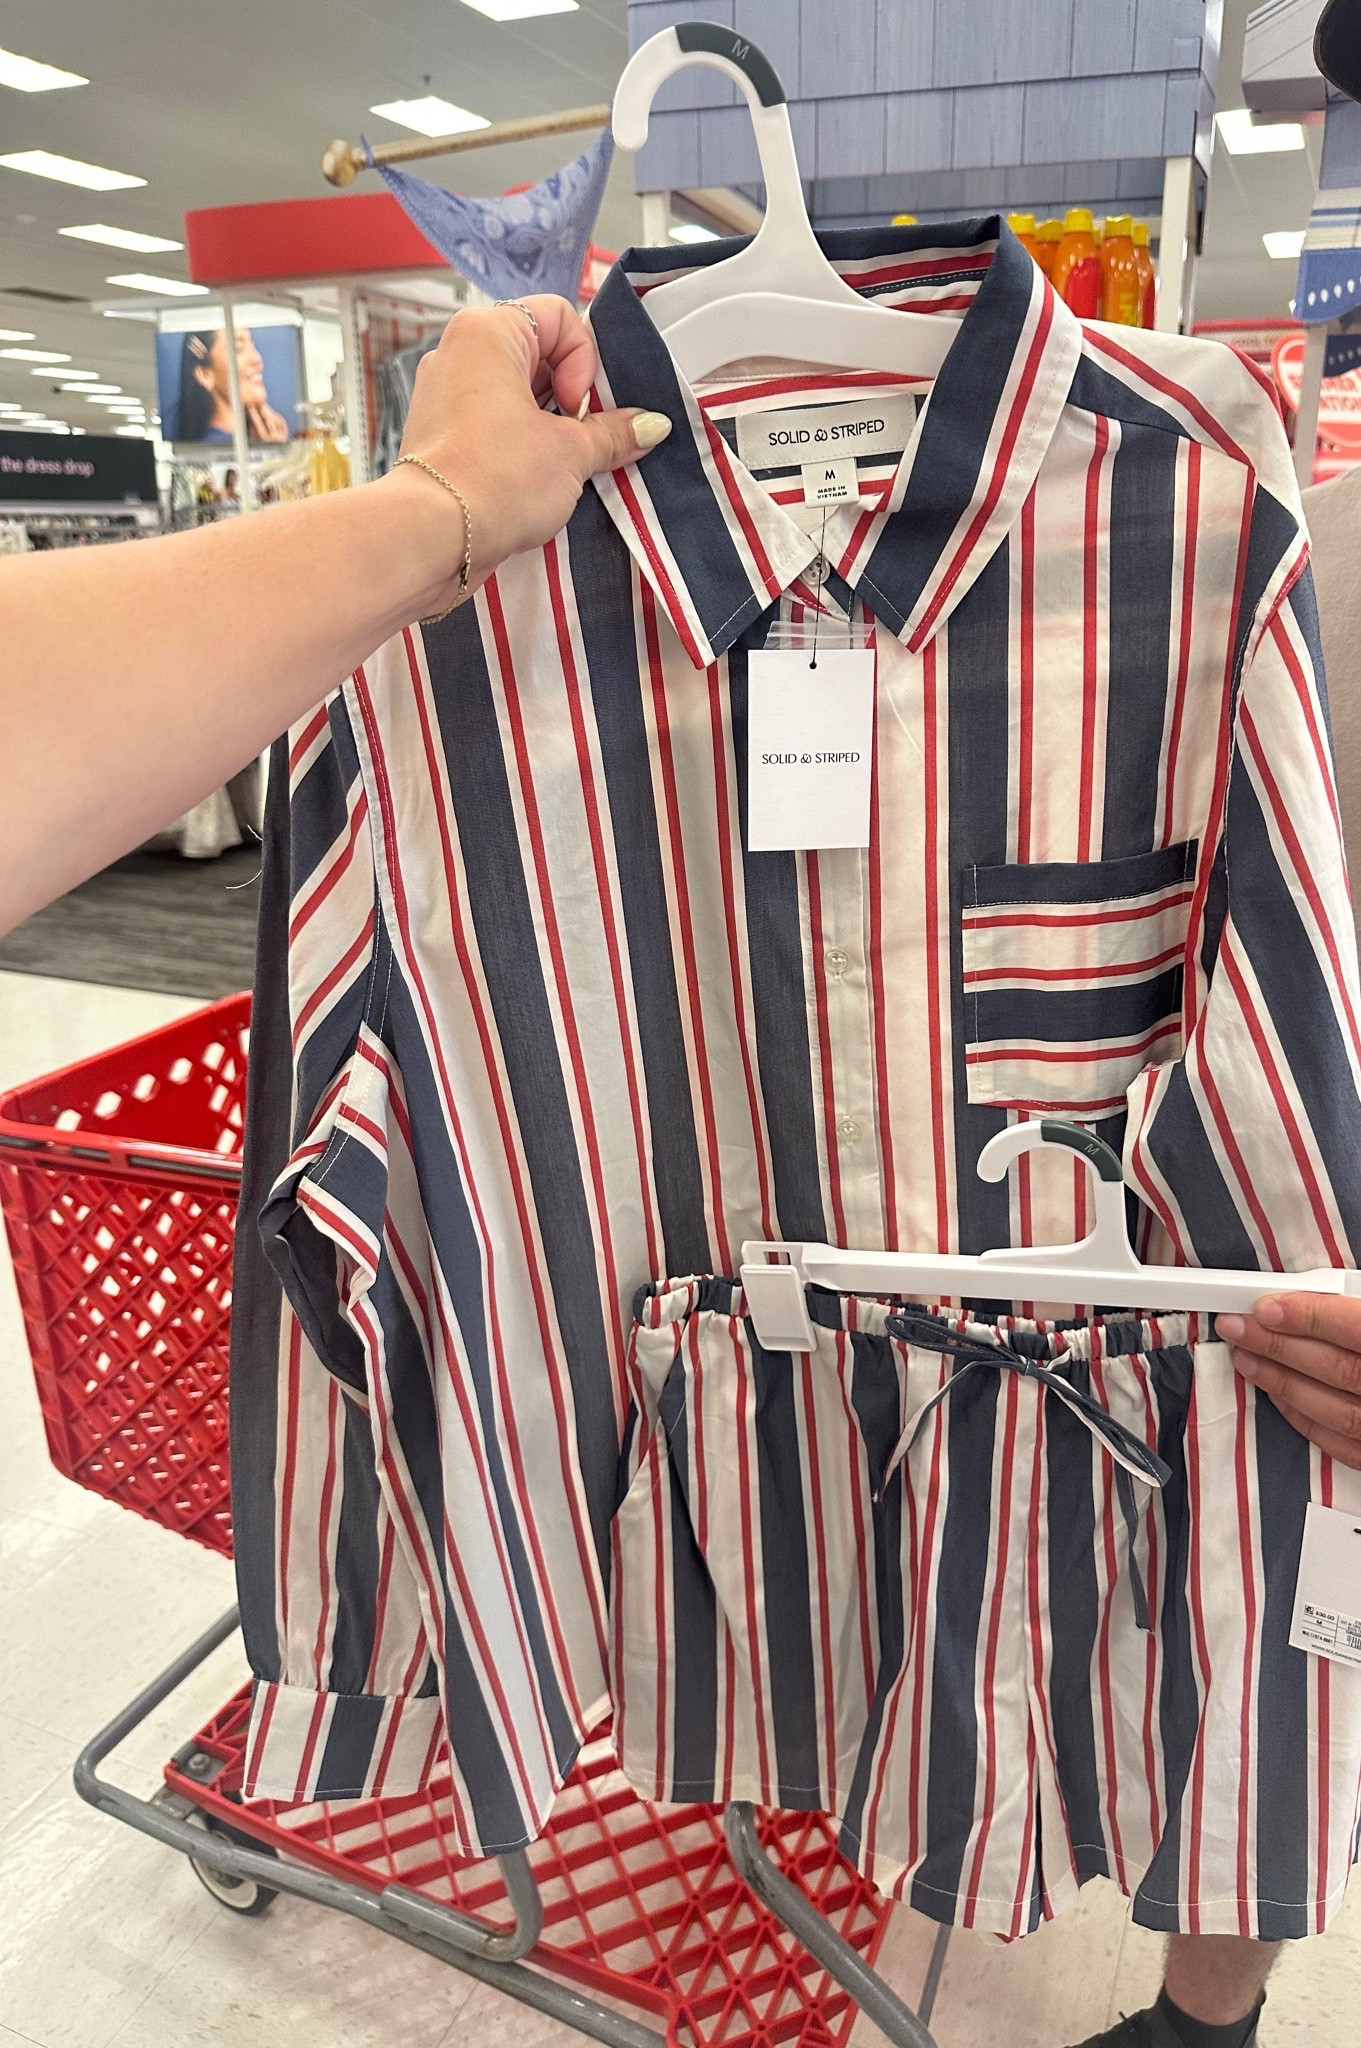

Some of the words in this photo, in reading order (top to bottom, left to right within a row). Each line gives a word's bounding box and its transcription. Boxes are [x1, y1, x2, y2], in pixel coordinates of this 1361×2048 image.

[731, 38, 750, 61] M
[769, 430, 811, 446] SOLID
[814, 428, 828, 442] &
[831, 419, 885, 440] STRIPED
[0, 455, 23, 473] the
[25, 456, 63, 475] dress
[63, 458, 95, 479] drop
[825, 469, 836, 480] M
[817, 486, 836, 494] MADE
[817, 491, 848, 499] VIETNAM
[762, 753, 797, 765] SOLID
[800, 753, 812, 763] &
[815, 752, 860, 763] STRIPED
[1084, 1143, 1099, 1156] M
[1315, 1610, 1335, 1621] $30.00
